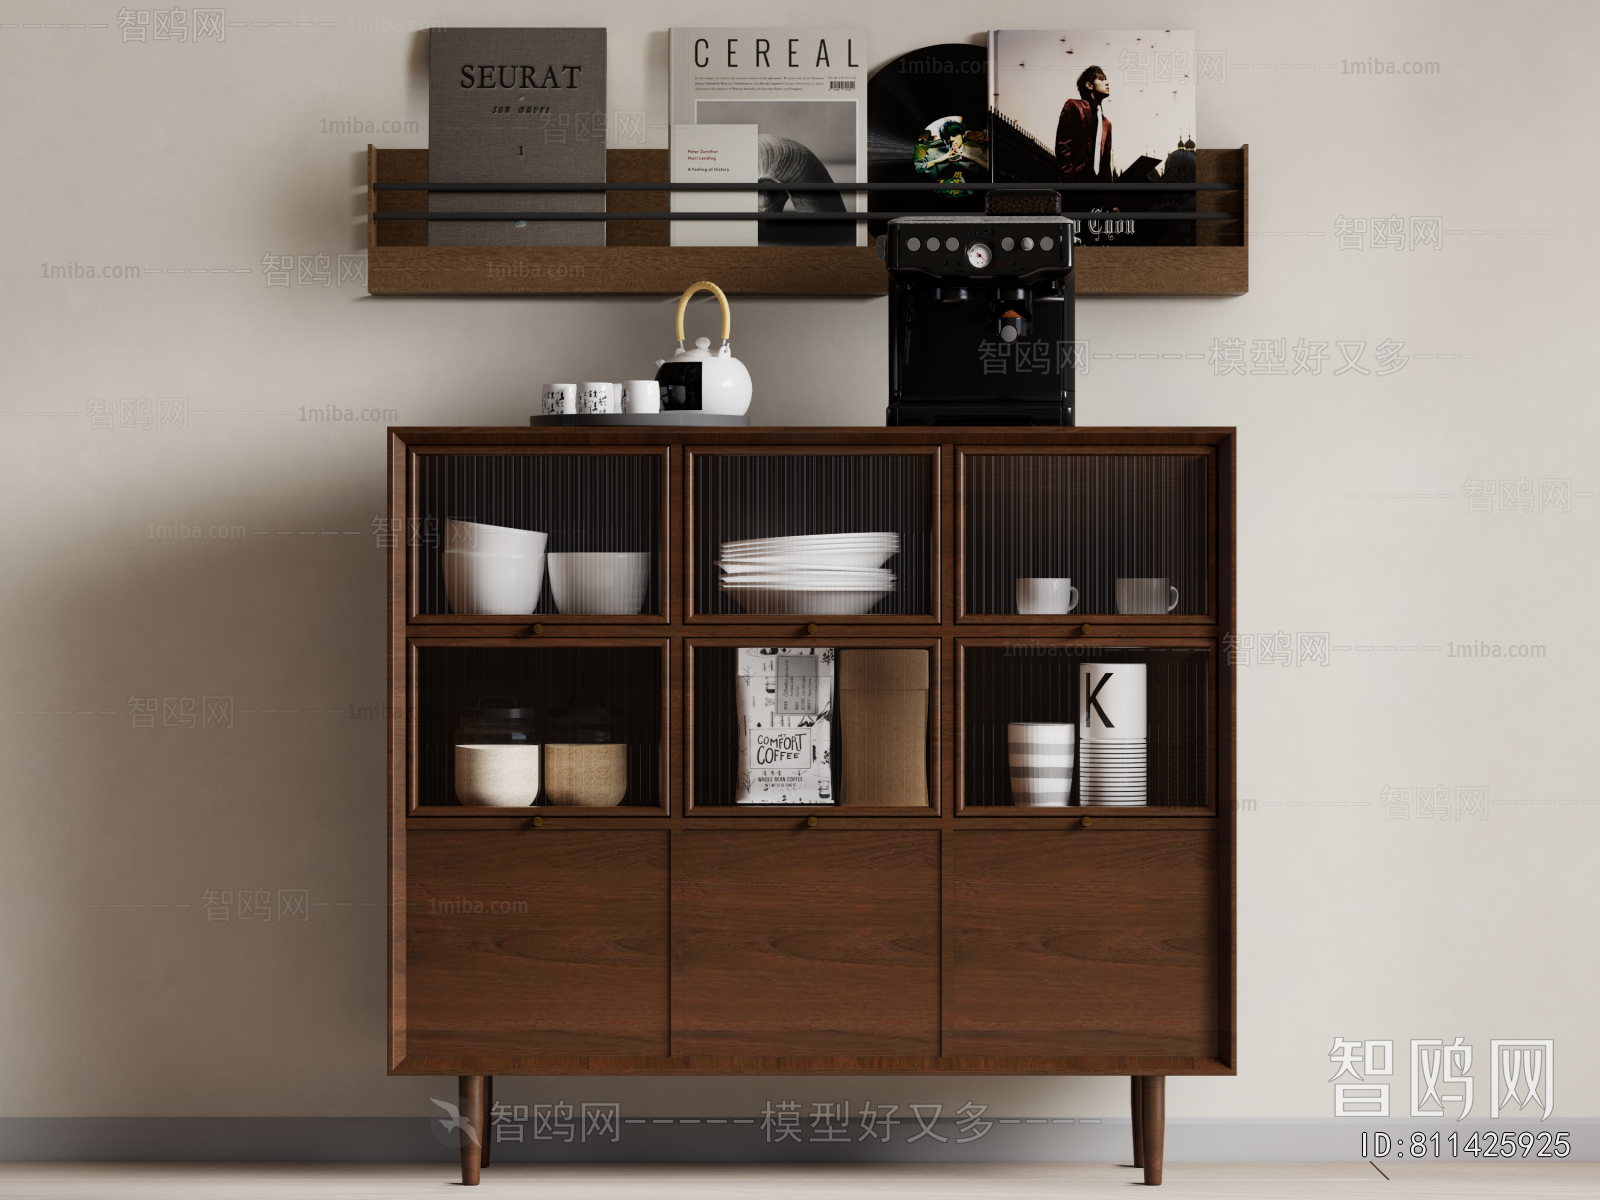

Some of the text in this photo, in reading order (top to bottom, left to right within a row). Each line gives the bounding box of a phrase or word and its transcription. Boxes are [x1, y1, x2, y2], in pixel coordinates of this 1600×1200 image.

[694, 38, 860, 68] CEREAL
[460, 64, 582, 90] SEURAT
[492, 106, 511, 114] son
[1085, 672, 1116, 729] K
[757, 732, 807, 752] COMFORT
[756, 746, 800, 765] COFFEE
